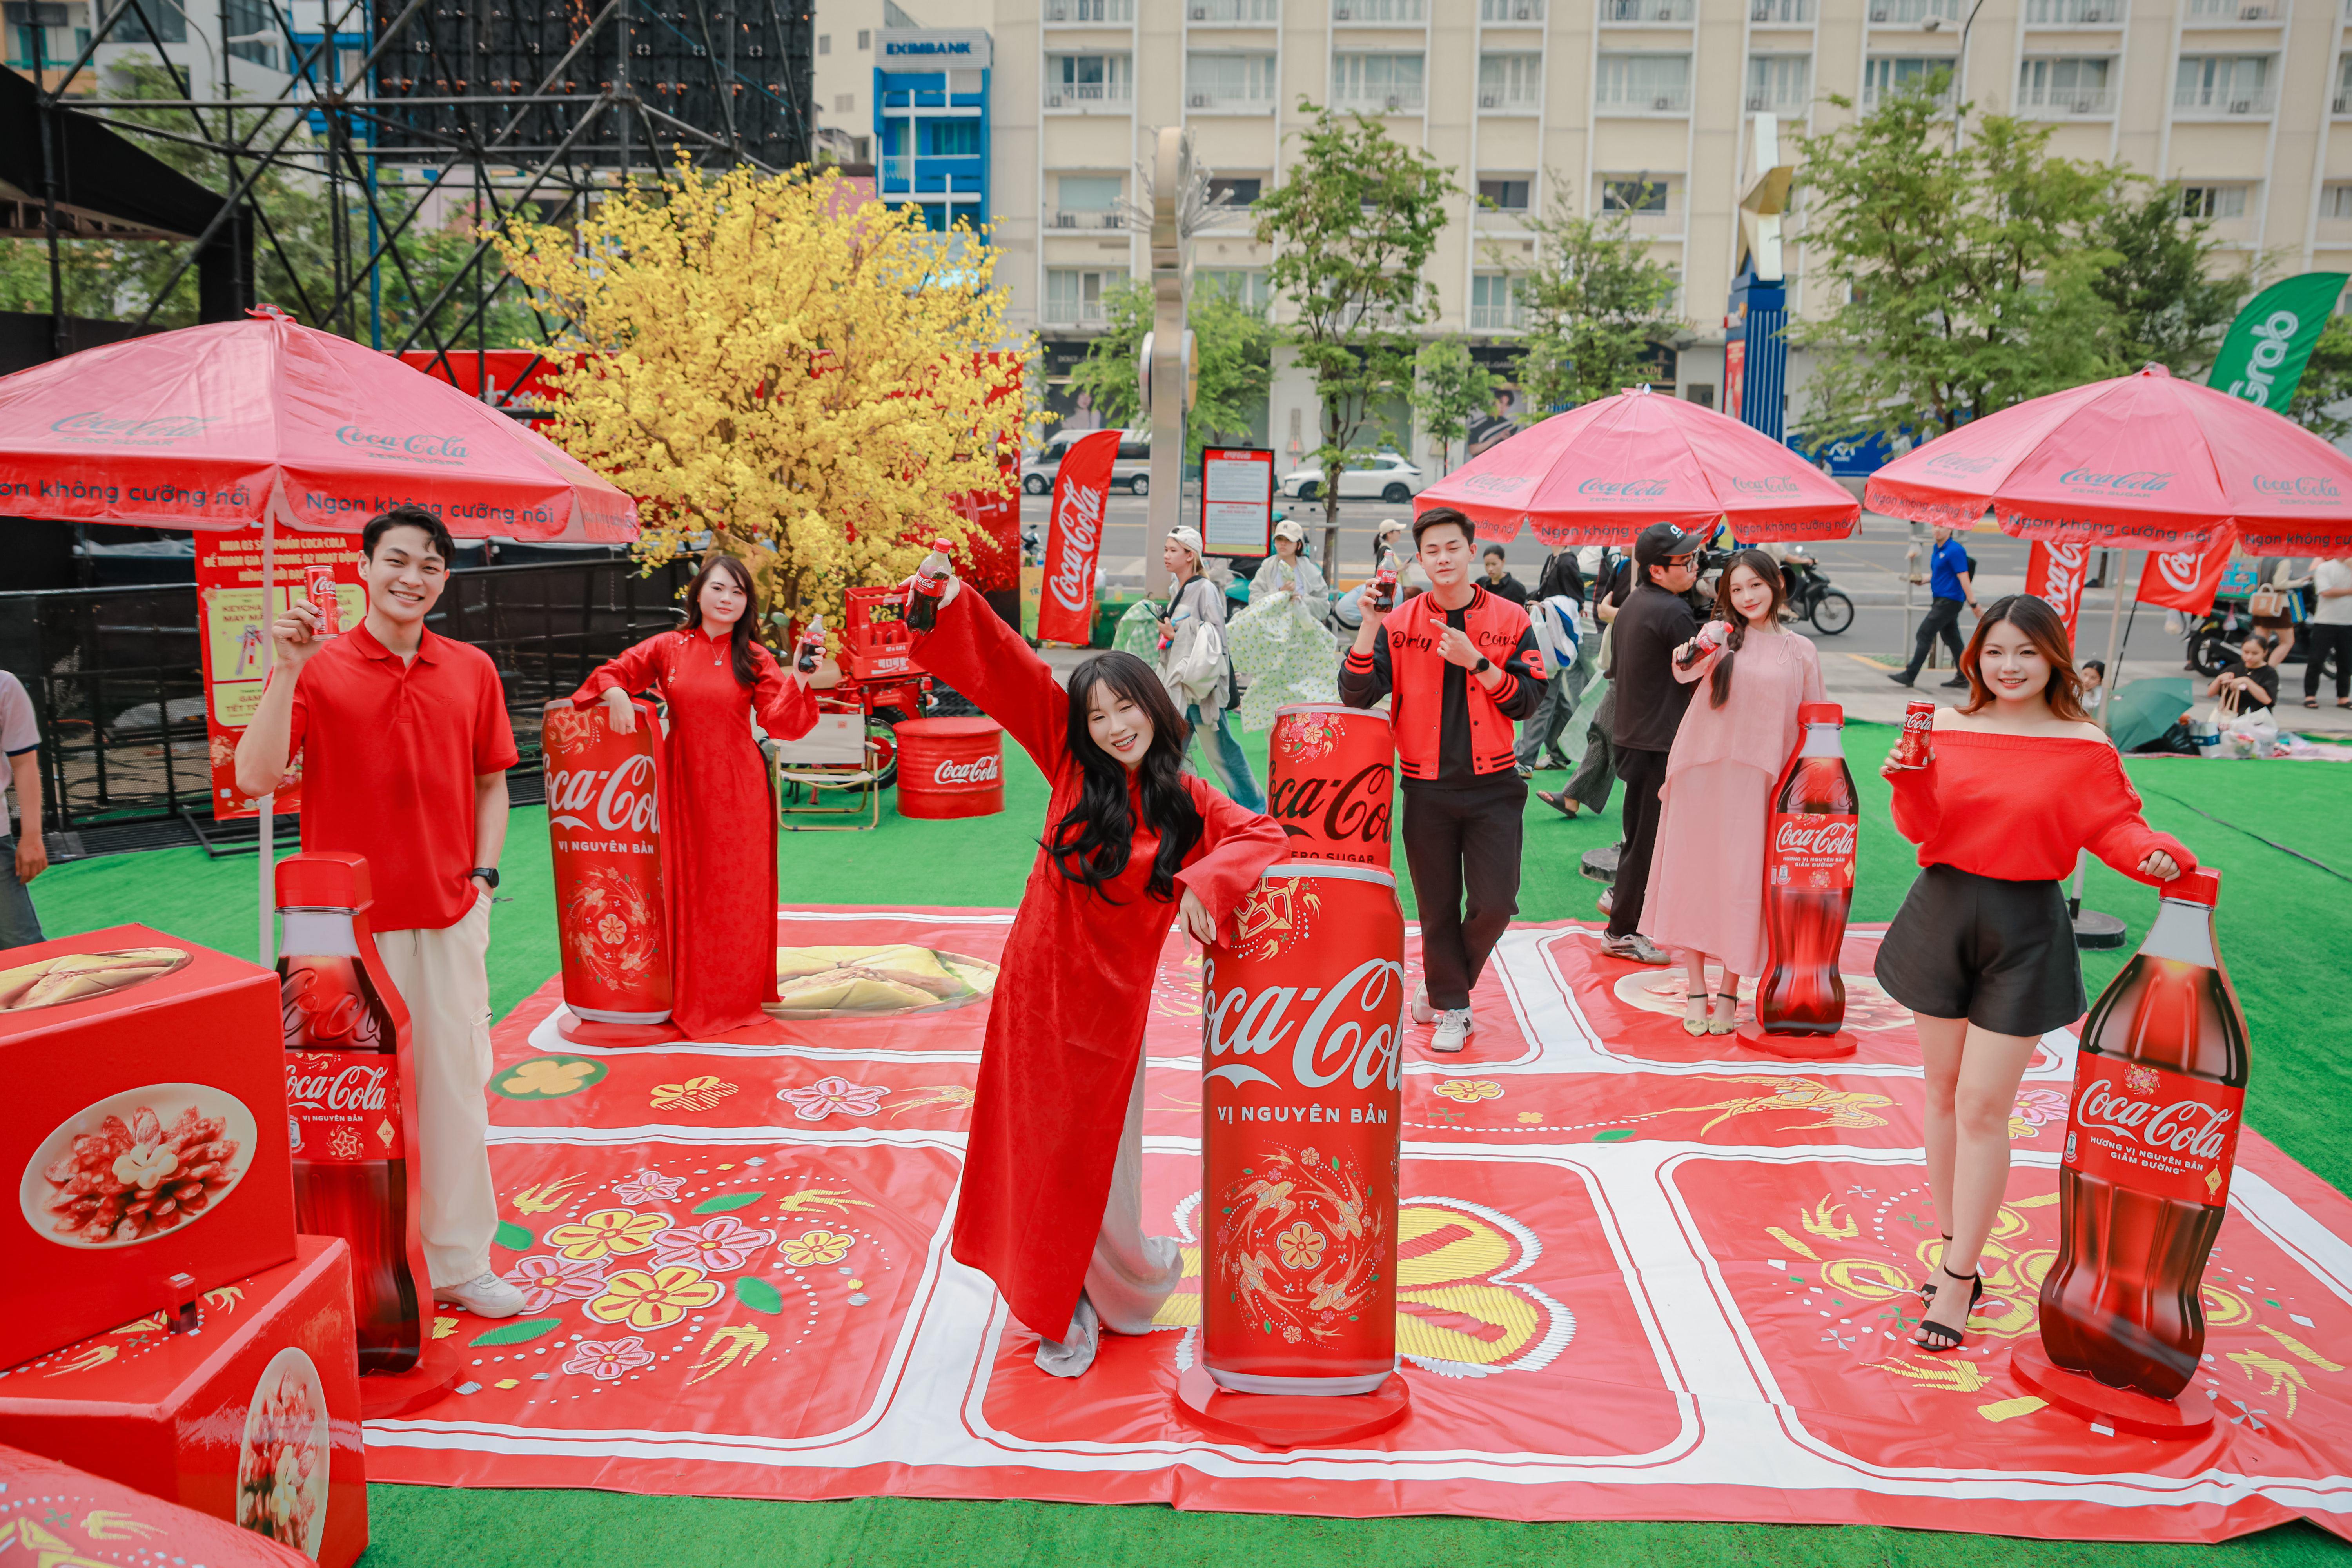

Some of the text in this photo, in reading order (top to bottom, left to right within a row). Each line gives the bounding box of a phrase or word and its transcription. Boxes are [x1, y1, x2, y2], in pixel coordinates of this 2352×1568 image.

[886, 42, 971, 54] EXIMBANK
[336, 425, 469, 459] Coca-Cola
[1578, 477, 1673, 496] Coca-Cola
[1733, 475, 1799, 493] Coca-Cola
[2059, 468, 2180, 491] Coca-Cola
[2253, 475, 2341, 496] Coca-Cola
[0, 480, 250, 507] on không cưỡng nổi
[306, 492, 366, 514] Ngon
[450, 503, 514, 524] cưỡng
[523, 504, 554, 523] nổi
[1541, 526, 1579, 538] Ngon
[1584, 525, 1629, 538] không
[1735, 523, 1762, 536] Ngon
[1765, 520, 1797, 533] không
[2008, 515, 2053, 530] Ngon
[2060, 518, 2114, 536] không
[2121, 525, 2177, 542] cưỡng
[219, 540, 241, 551] MUA
[301, 538, 347, 548] COCA-COLA
[1050, 475, 1101, 611] Coca-Cola
[2245, 534, 2281, 547] Ngon
[2286, 532, 2330, 547] không
[339, 549, 358, 565] ĐỘN
[935, 754, 1000, 784] Coca-Cola
[558, 840, 654, 854] VỊ NGUYÊN BẢN
[1775, 821, 1857, 854] Coca-Cola
[1291, 851, 1319, 859] ERO
[1218, 1103, 1387, 1125] VỊ NGUYÊN BẢN
[2077, 1079, 2234, 1160] Coca-Cola
[2090, 1136, 2122, 1151] HƯƠNG
[2125, 1146, 2136, 1156] VỊ
[2139, 1150, 2181, 1167] NGUYÊN
[2184, 1160, 2203, 1171] BẢN
[2111, 1151, 2138, 1164] GIẢM
